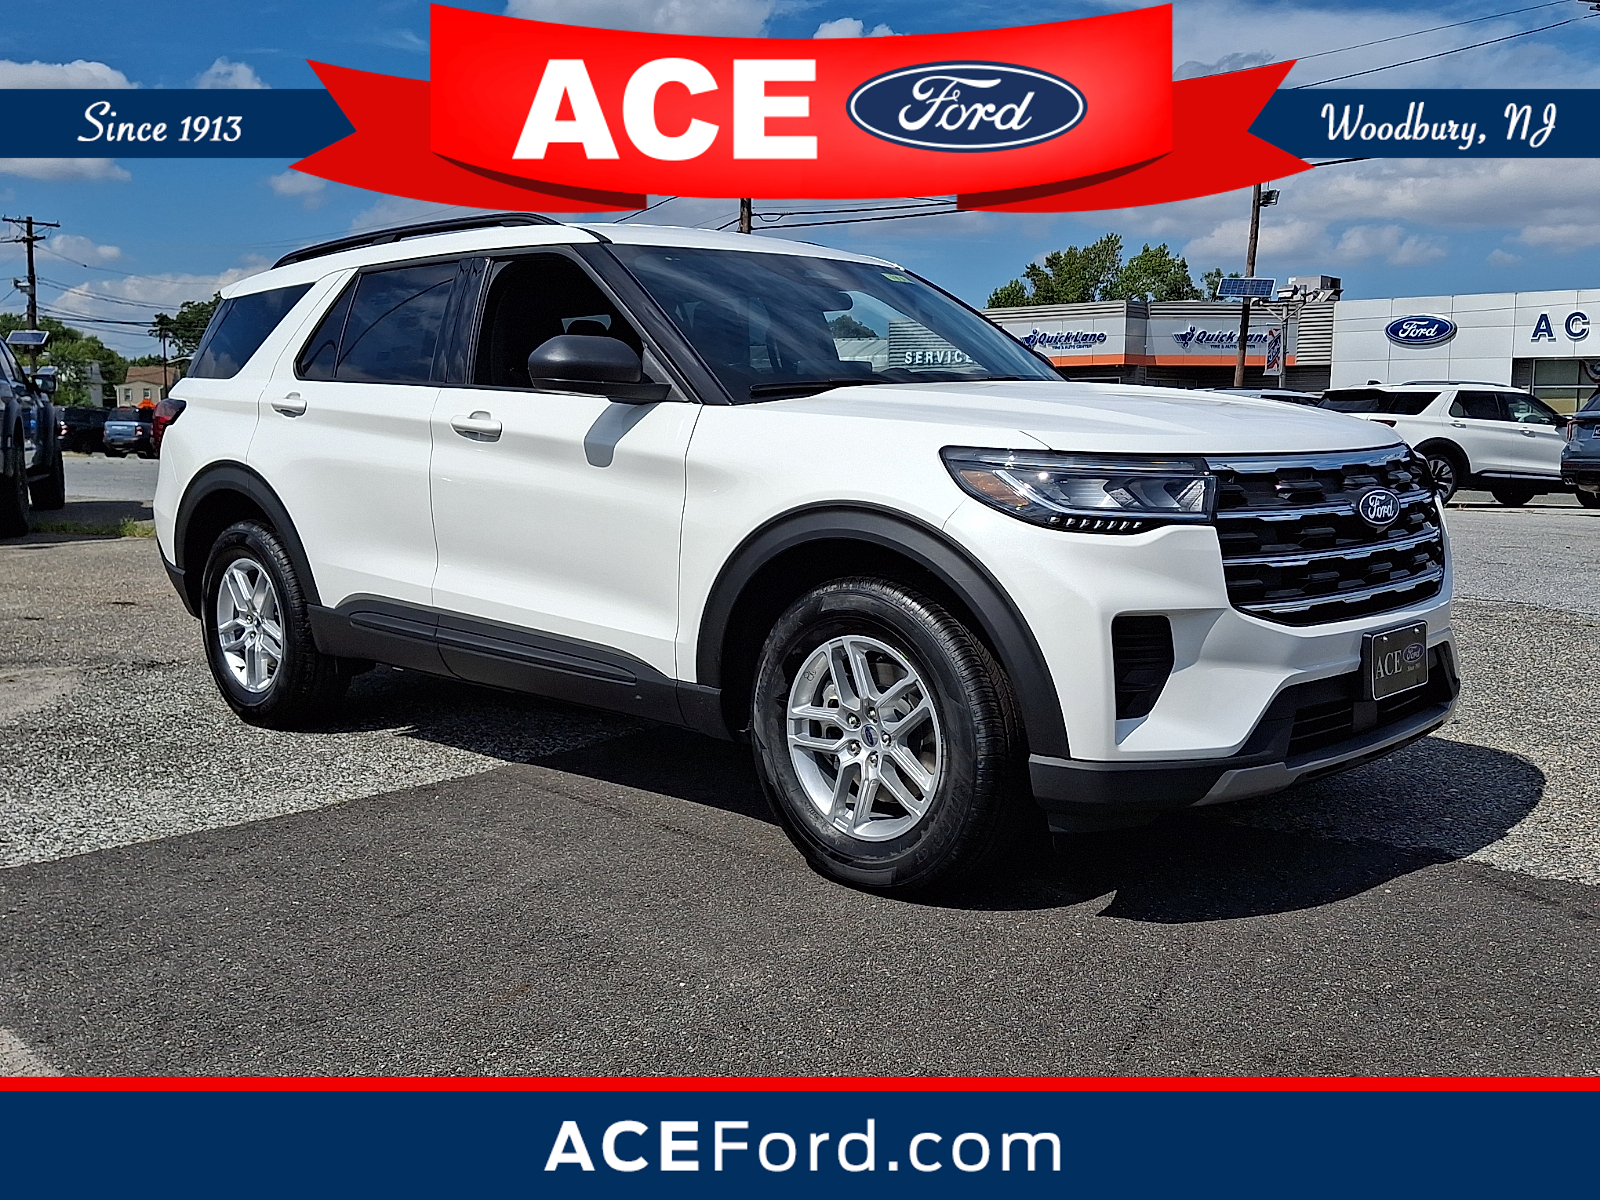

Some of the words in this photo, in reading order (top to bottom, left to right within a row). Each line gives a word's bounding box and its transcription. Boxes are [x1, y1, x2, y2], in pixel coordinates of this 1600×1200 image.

[1037, 331, 1073, 345] Quick
[1073, 331, 1107, 344] Lane
[1195, 330, 1236, 344] Quick
[1398, 320, 1438, 338] Ford
[1368, 494, 1395, 519] Ford
[1375, 649, 1403, 680] ACE
